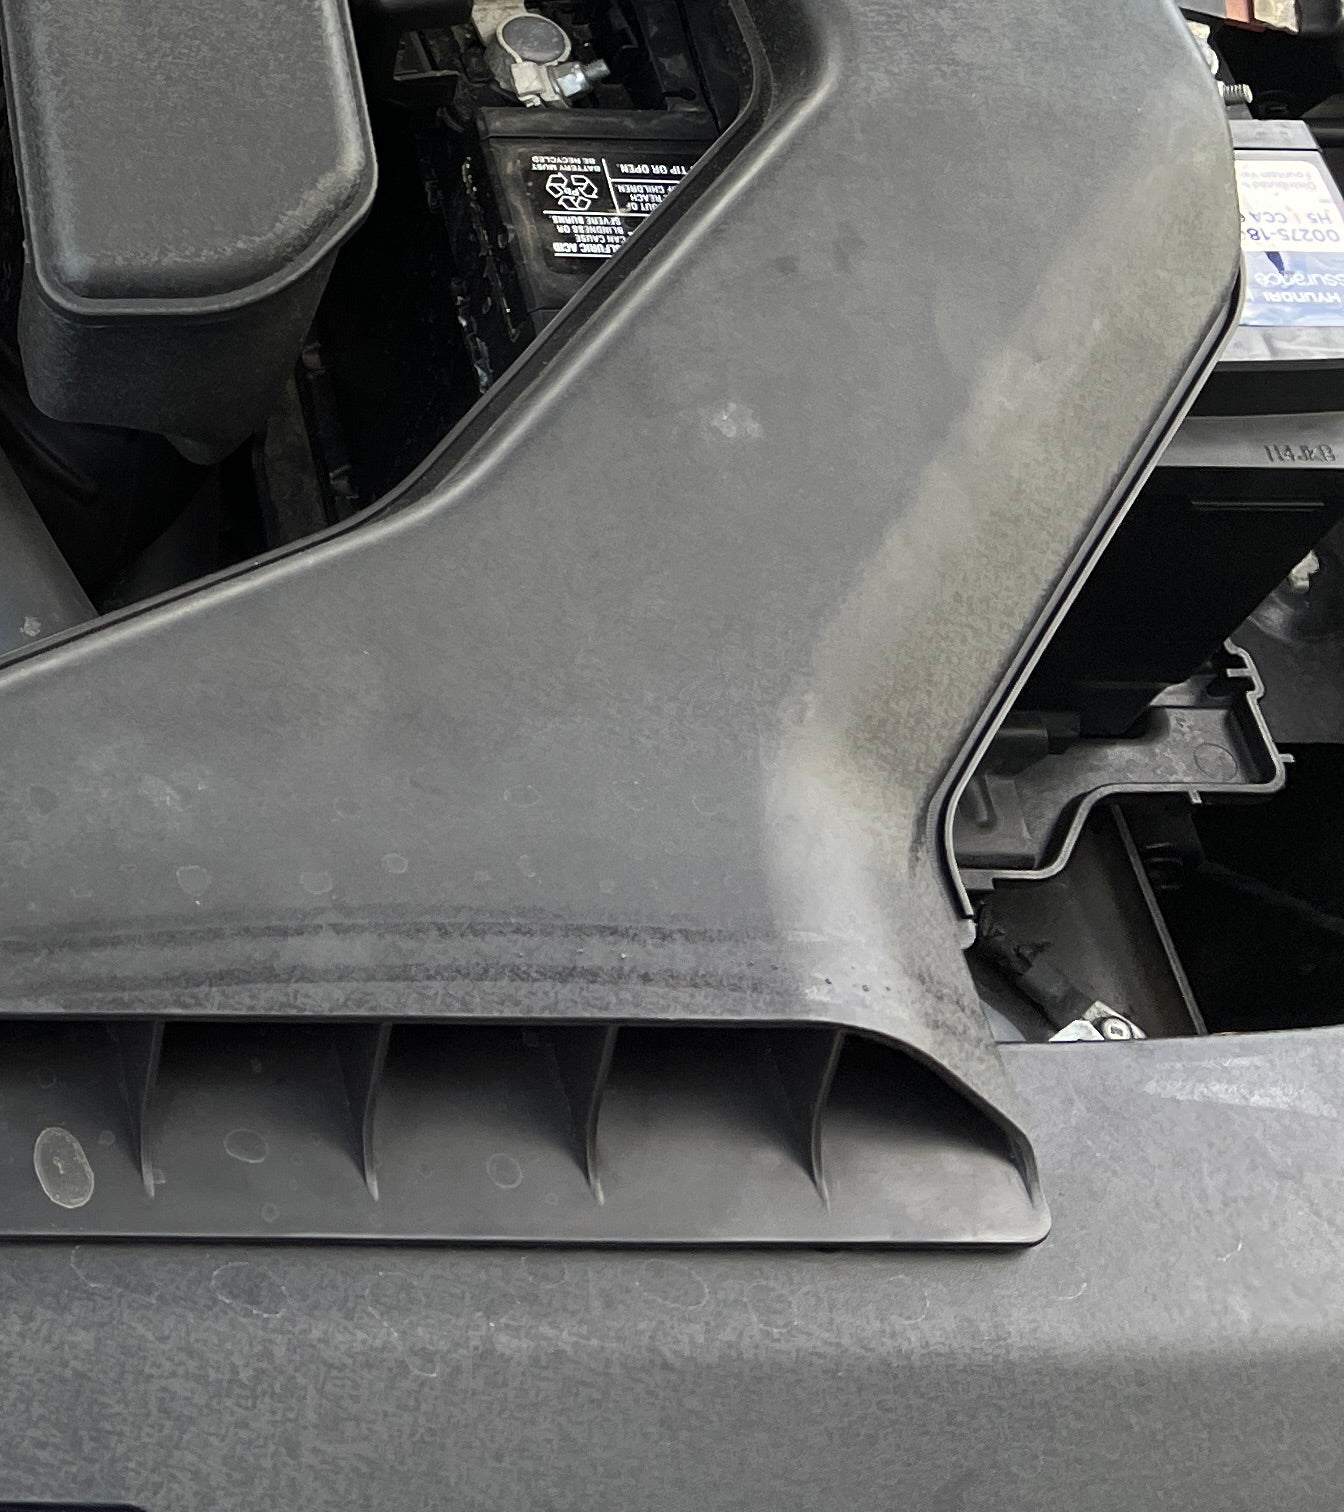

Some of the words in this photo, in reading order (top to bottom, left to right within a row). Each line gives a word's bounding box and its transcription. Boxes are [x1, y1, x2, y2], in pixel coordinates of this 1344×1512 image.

[531, 155, 581, 165] RECYCLED
[580, 156, 596, 165] BE
[530, 162, 558, 172] MUST
[557, 163, 601, 173] BATTERY
[650, 164, 668, 175] OR
[669, 165, 688, 175] TIP
[629, 193, 663, 203] REACH
[625, 201, 639, 210] OF
[585, 216, 622, 226] SEVERE
[1248, 211, 1288, 224] CCA
[556, 224, 571, 234] OR
[572, 225, 624, 235] BLINDNESS
[574, 233, 606, 243] CAUSE
[552, 242, 578, 253] ACID
[1254, 272, 1344, 288] ssurance
[1262, 291, 1342, 303] HYUNDAI
